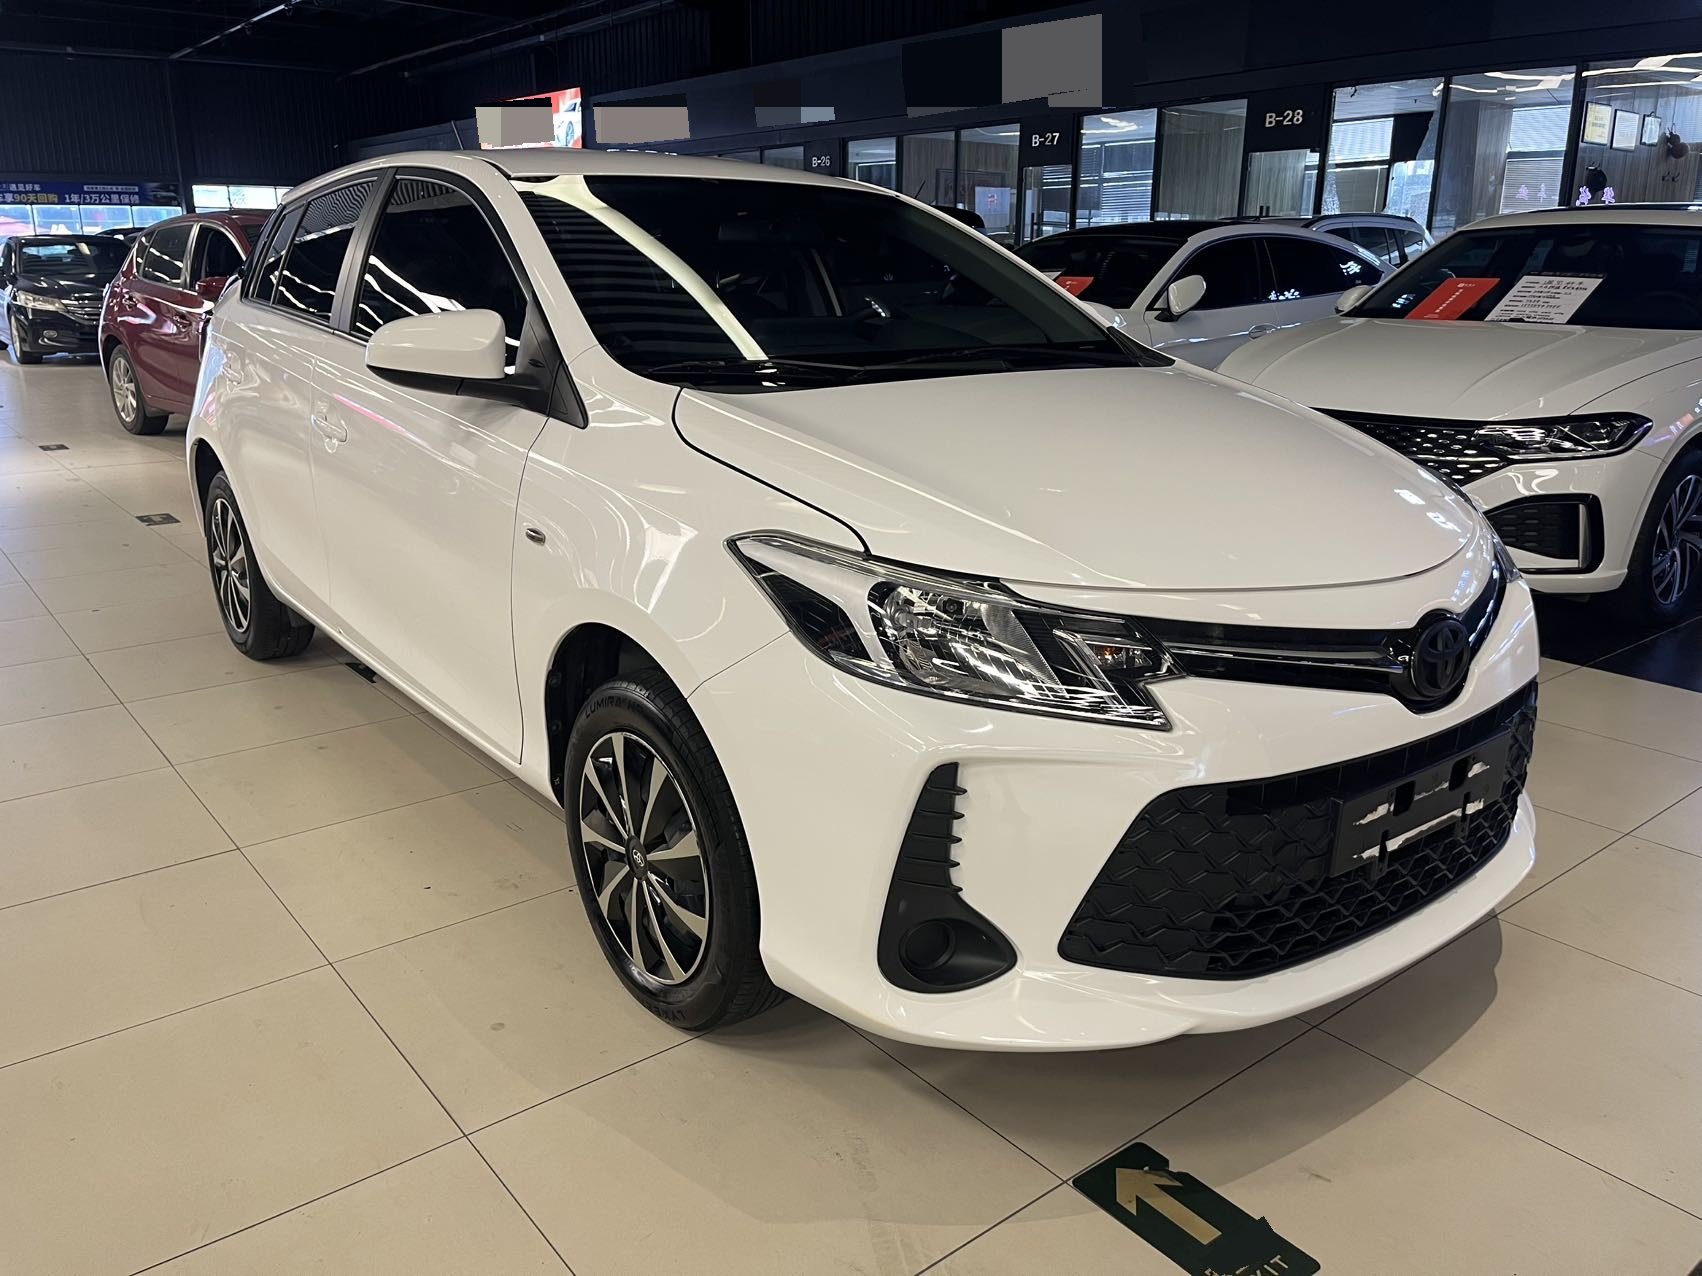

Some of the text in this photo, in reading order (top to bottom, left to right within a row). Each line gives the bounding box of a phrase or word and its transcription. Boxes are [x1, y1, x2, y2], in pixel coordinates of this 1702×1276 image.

[1265, 109, 1303, 127] B-28
[1031, 132, 1060, 147] B-27
[812, 156, 830, 167] B-26
[65, 194, 139, 204] 1年/3万公里保修
